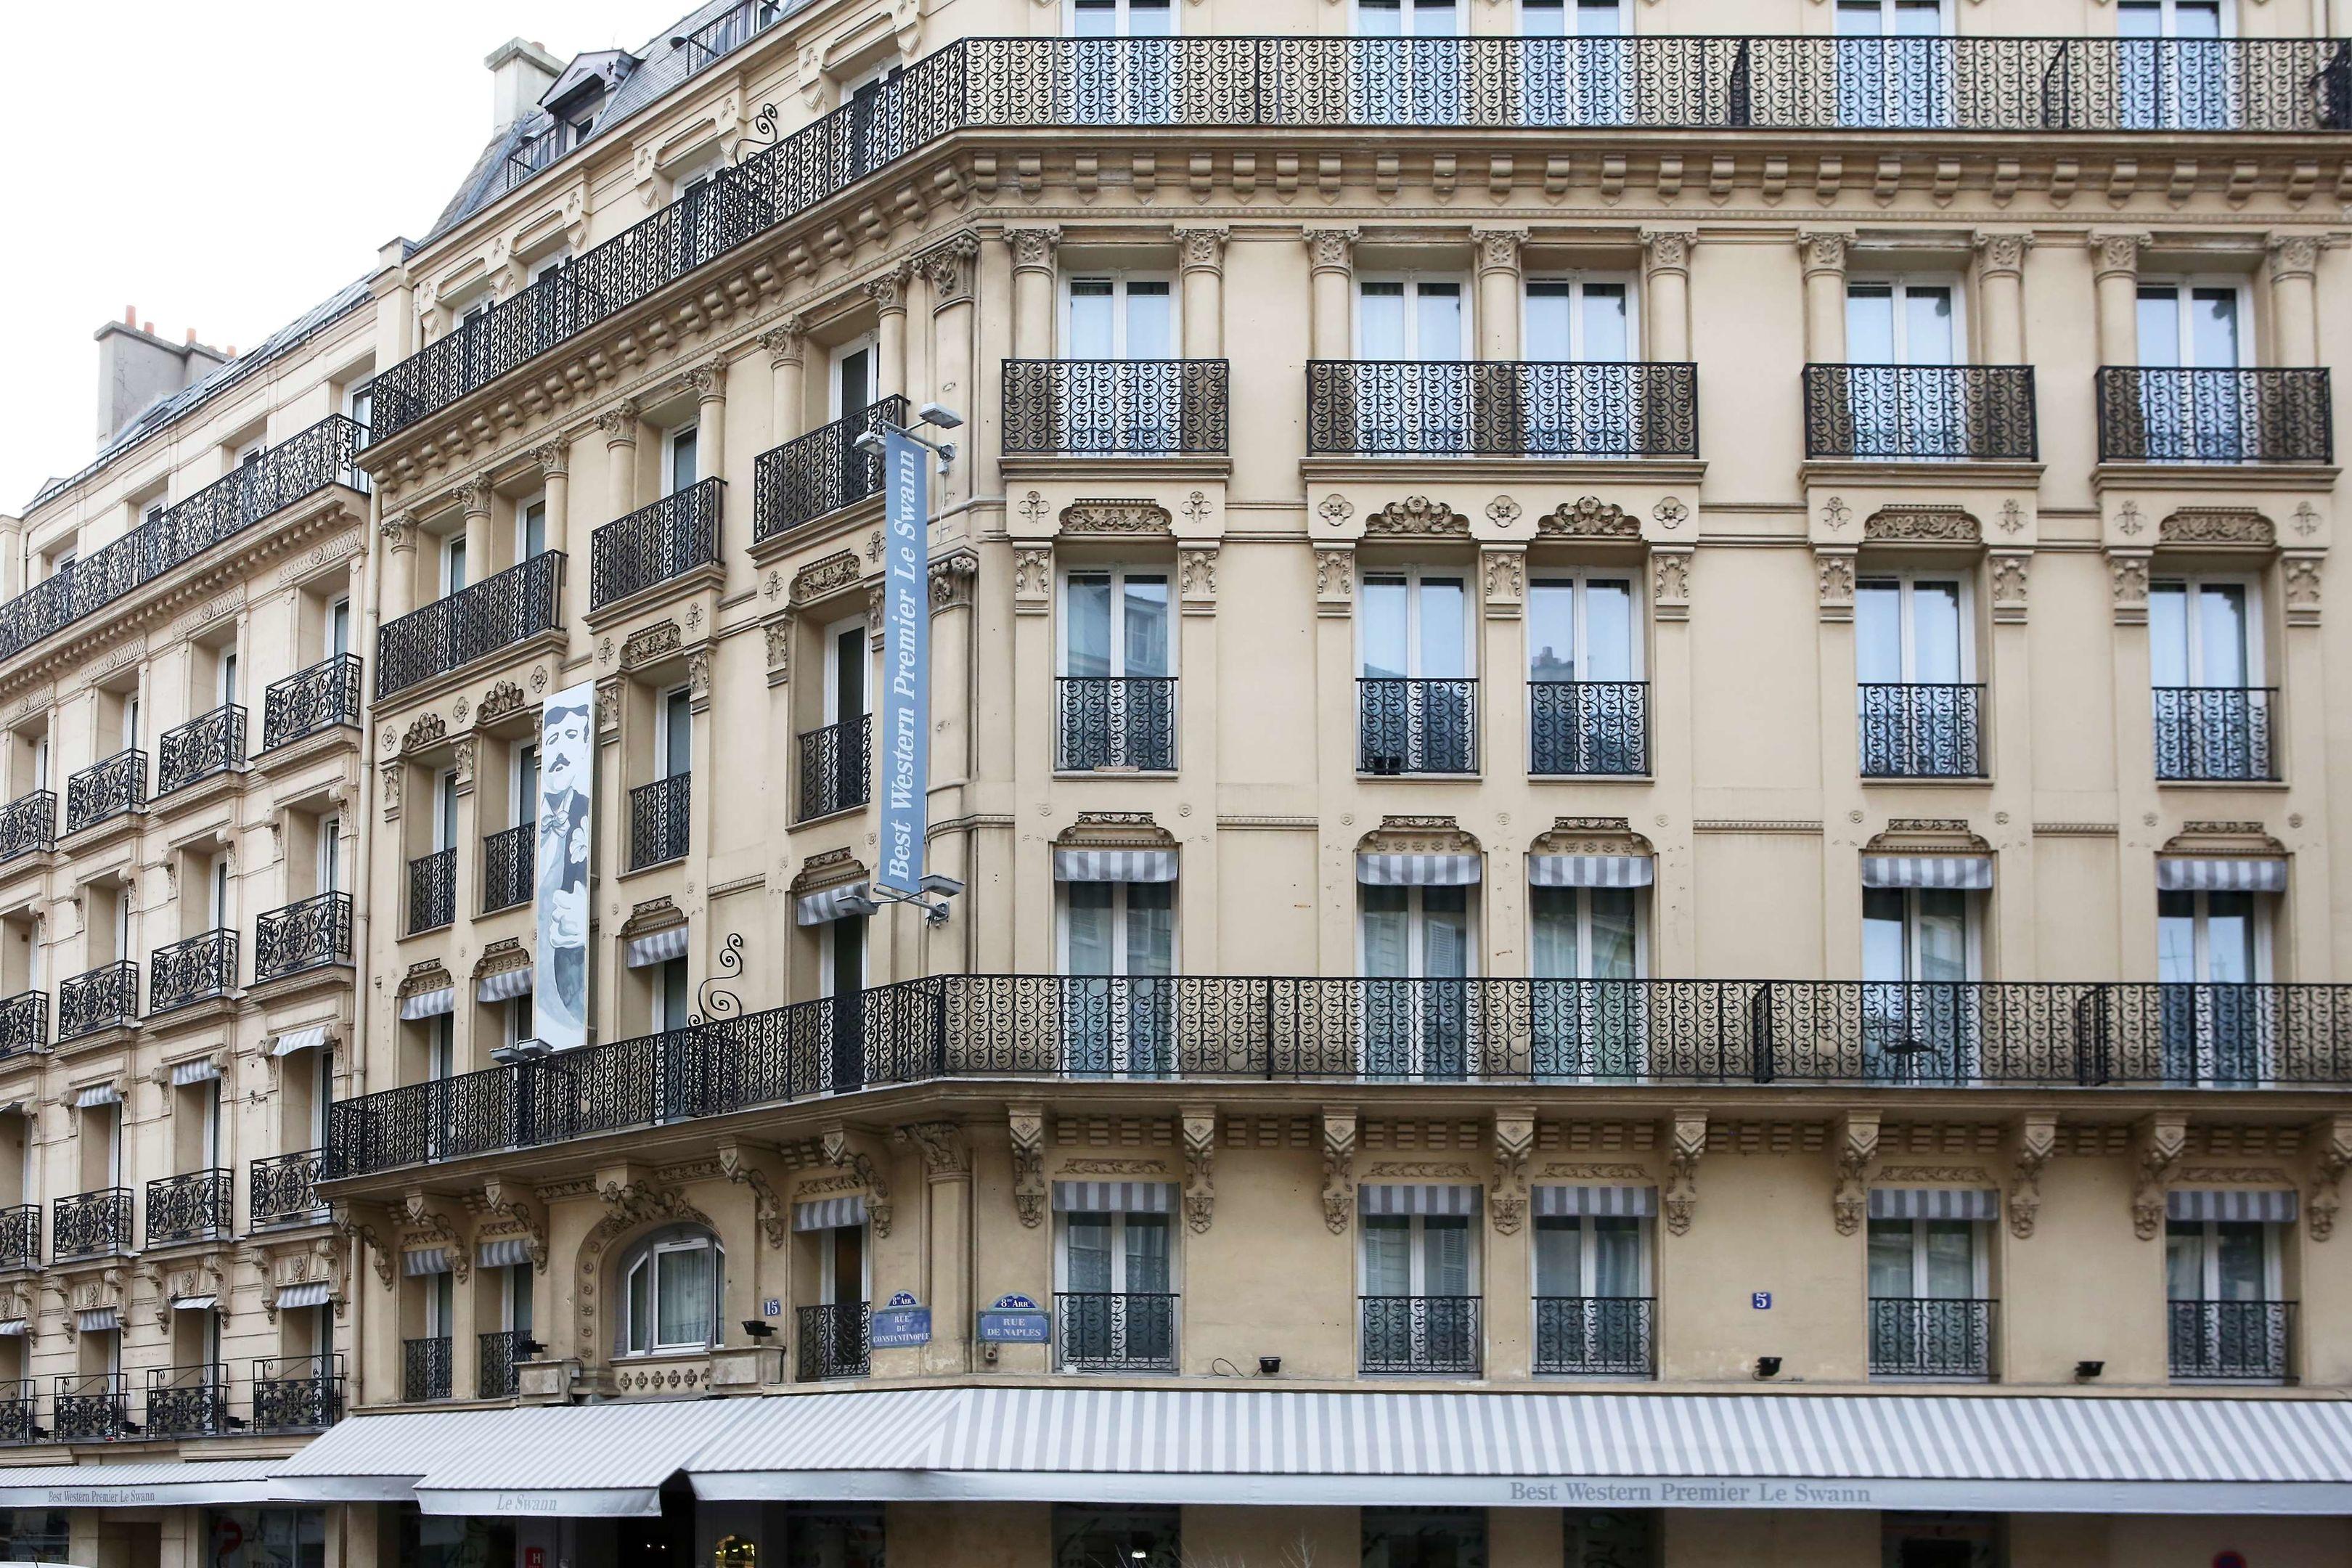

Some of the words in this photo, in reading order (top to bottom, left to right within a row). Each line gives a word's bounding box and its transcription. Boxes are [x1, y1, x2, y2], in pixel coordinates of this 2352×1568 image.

[894, 449, 916, 541] Swann
[894, 547, 916, 584] Le
[893, 587, 916, 701] Premier
[890, 706, 915, 812] Western
[889, 820, 912, 881] Best
[767, 1301, 778, 1315] 15
[1756, 1293, 1767, 1308] 5
[873, 1332, 930, 1342] CONSTANTINOPLE
[49, 1490, 62, 1503] Best
[64, 1490, 89, 1503] Western
[91, 1490, 118, 1503] Premier
[120, 1490, 128, 1503] Le
[131, 1490, 155, 1502] Swann
[496, 1494, 513, 1511] Le
[515, 1493, 558, 1511] Swann
[1510, 1482, 1557, 1500] Best
[1564, 1482, 1651, 1501] Western
[1660, 1482, 1750, 1501] Premier
[1759, 1483, 1787, 1502] Le
[1794, 1483, 1871, 1503] Swann
